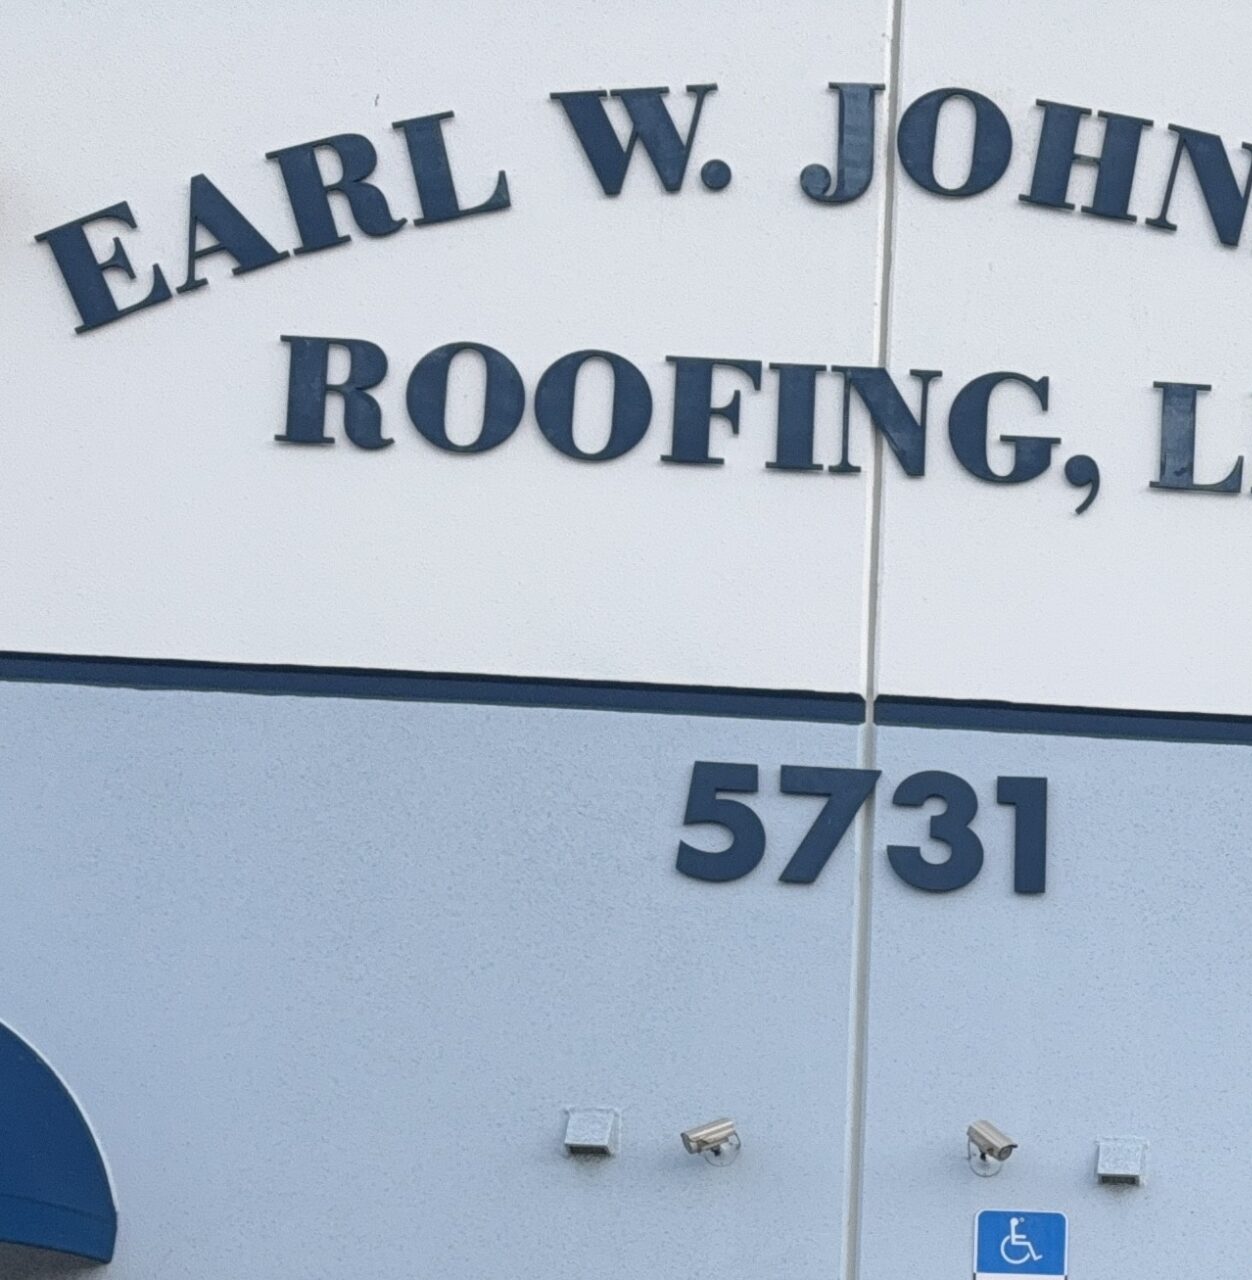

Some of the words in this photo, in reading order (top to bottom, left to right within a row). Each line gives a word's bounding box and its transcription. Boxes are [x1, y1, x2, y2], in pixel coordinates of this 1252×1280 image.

[35, 111, 512, 336] EARL
[549, 82, 732, 199] W.
[274, 335, 1101, 516] ROOFING,
[674, 760, 1049, 898] 5731
